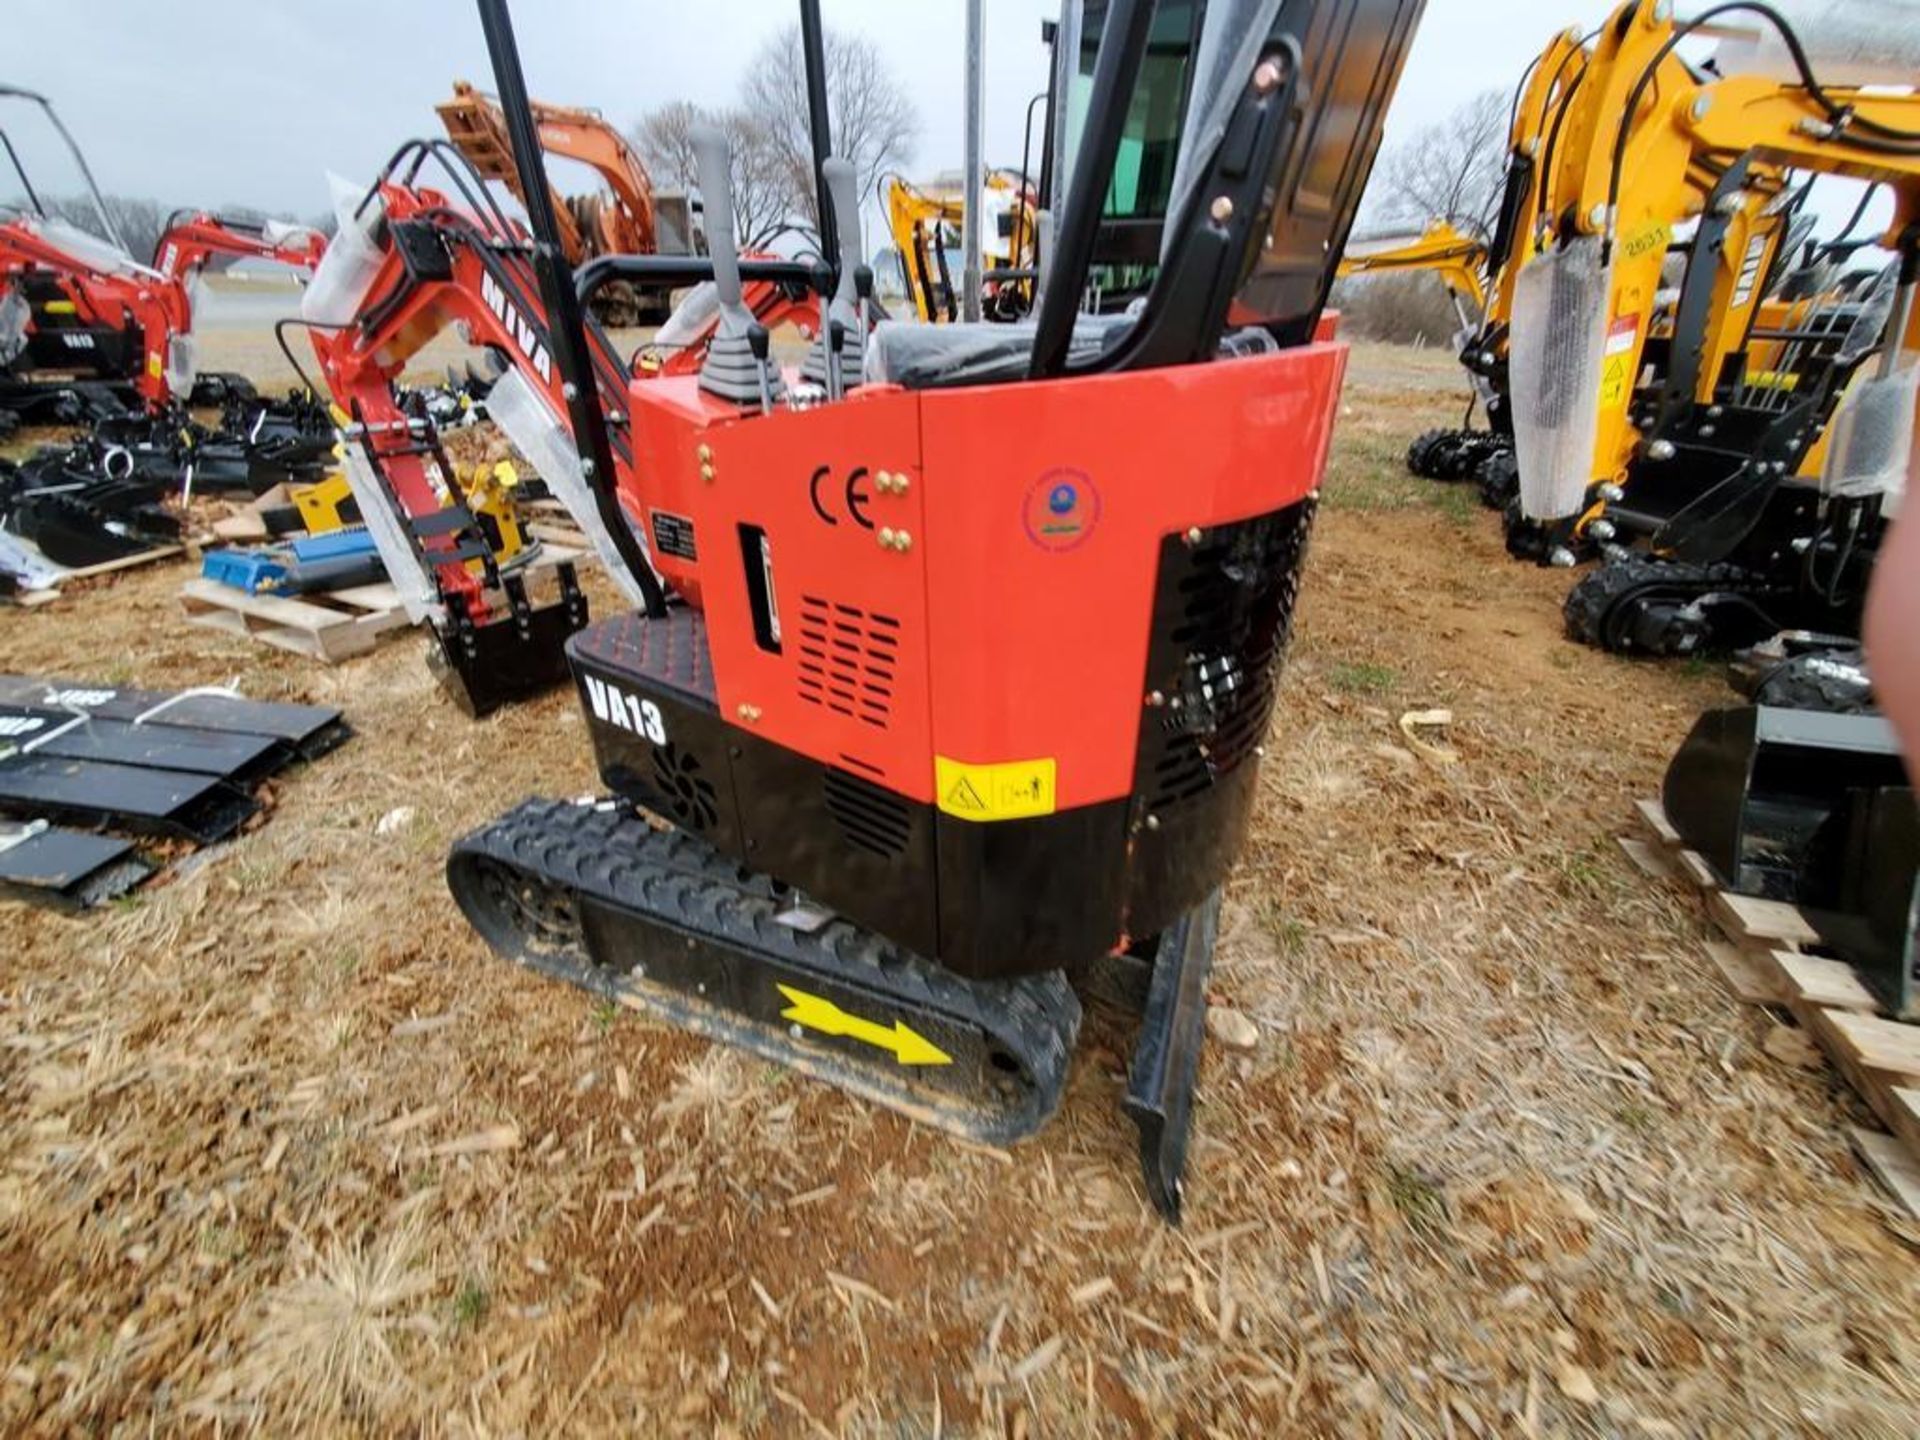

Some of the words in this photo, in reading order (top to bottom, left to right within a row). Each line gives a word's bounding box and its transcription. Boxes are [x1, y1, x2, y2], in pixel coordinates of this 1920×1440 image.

[481, 269, 551, 387] MIVA
[809, 464, 875, 531] CE
[584, 674, 667, 747] VA13
